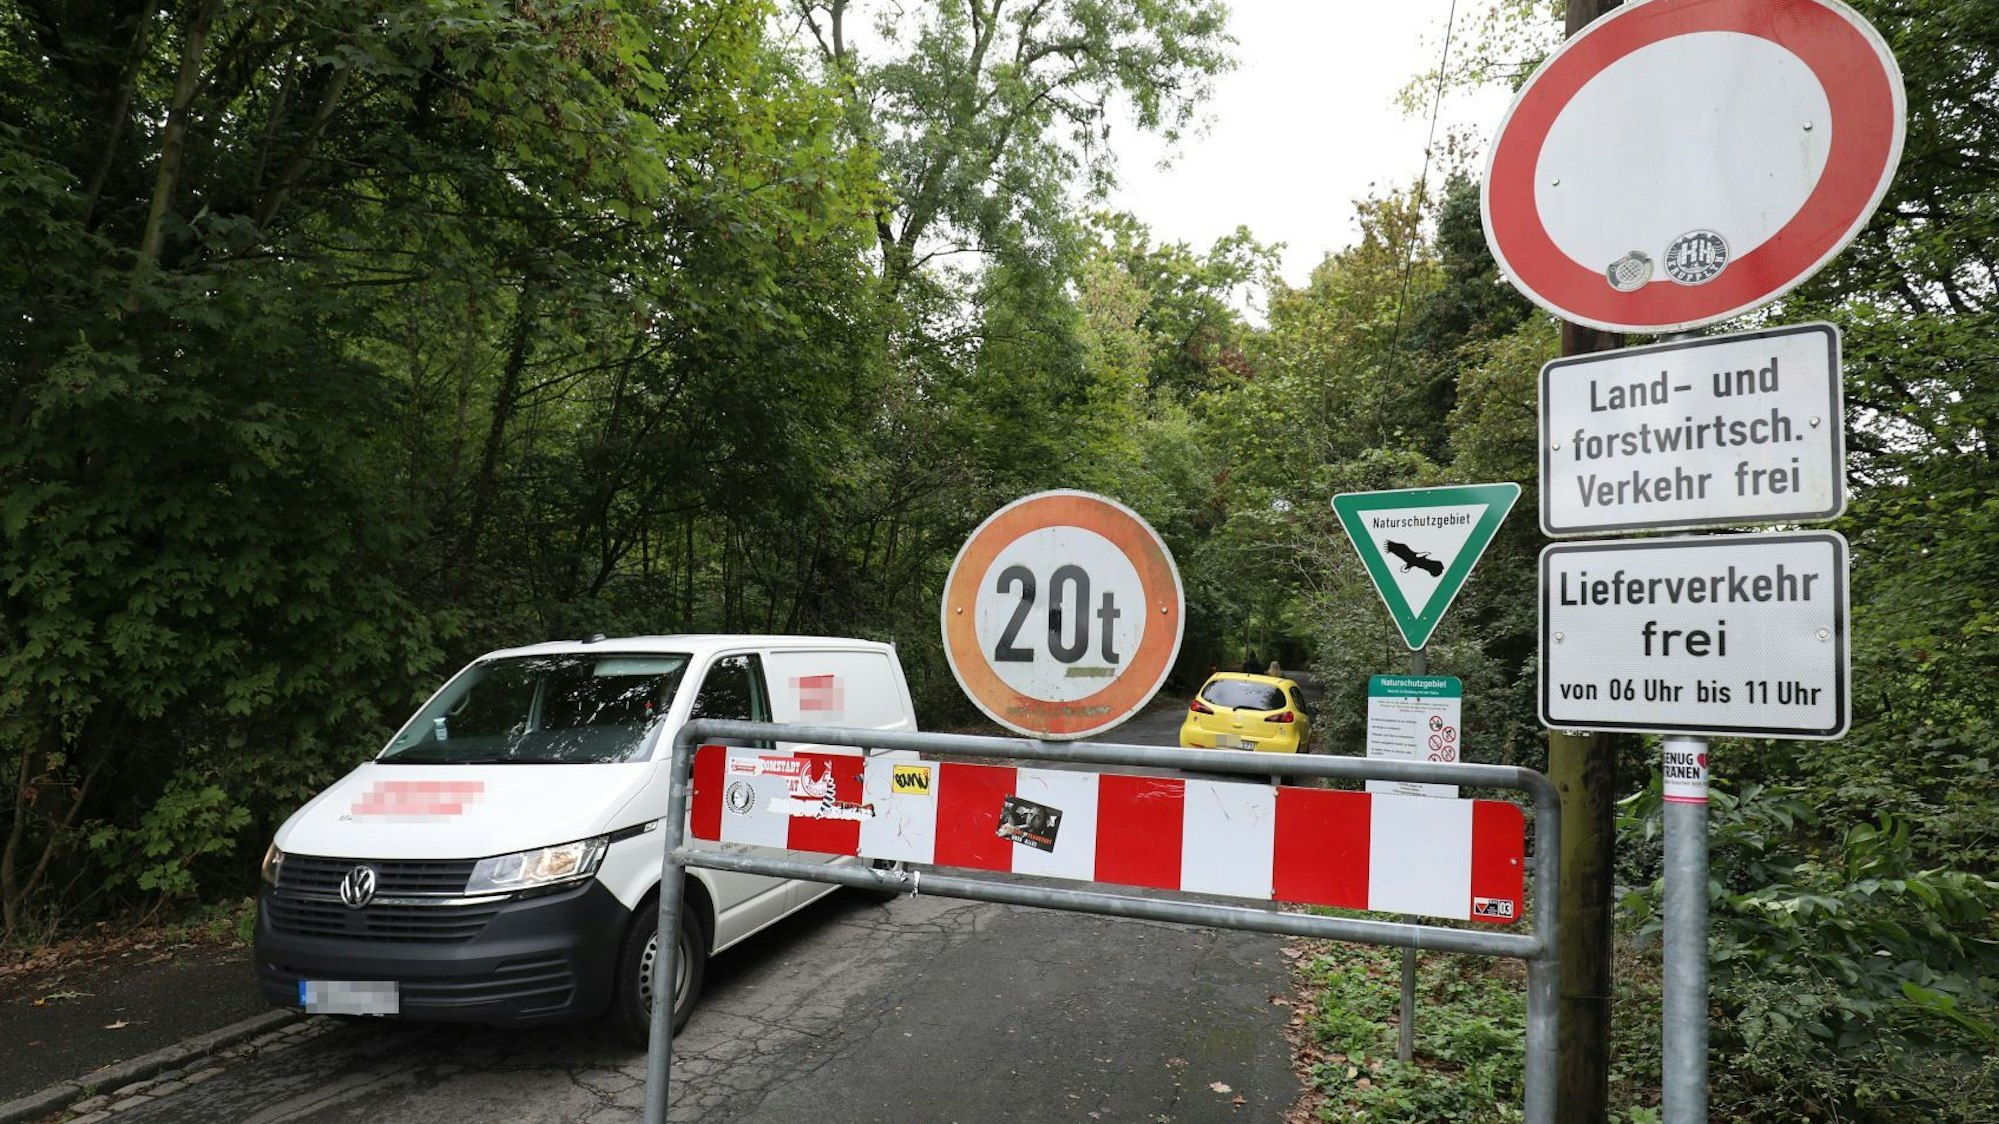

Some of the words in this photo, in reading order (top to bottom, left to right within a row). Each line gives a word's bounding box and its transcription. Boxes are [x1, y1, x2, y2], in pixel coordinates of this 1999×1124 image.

[1590, 370, 1692, 413] Land-
[1713, 357, 1779, 398] und
[1572, 407, 1803, 461] forstwirtsch.
[1577, 466, 1712, 508] Verkehr
[1735, 457, 1800, 497] frei
[1373, 513, 1471, 529] Naturschutzgebiet
[1560, 563, 1819, 606] Lieferverkehr
[1642, 619, 1726, 657] frei
[1380, 678, 1447, 689] Naturschutzgebiet
[1560, 683, 1597, 700] von
[1609, 679, 1635, 701] 06
[1645, 679, 1684, 702] Uhr
[1697, 680, 1731, 704] bis
[1745, 681, 1768, 704] 11
[1778, 681, 1822, 706] Uhr
[1663, 752, 1694, 765] ENUG
[1500, 901, 1512, 915] 03
